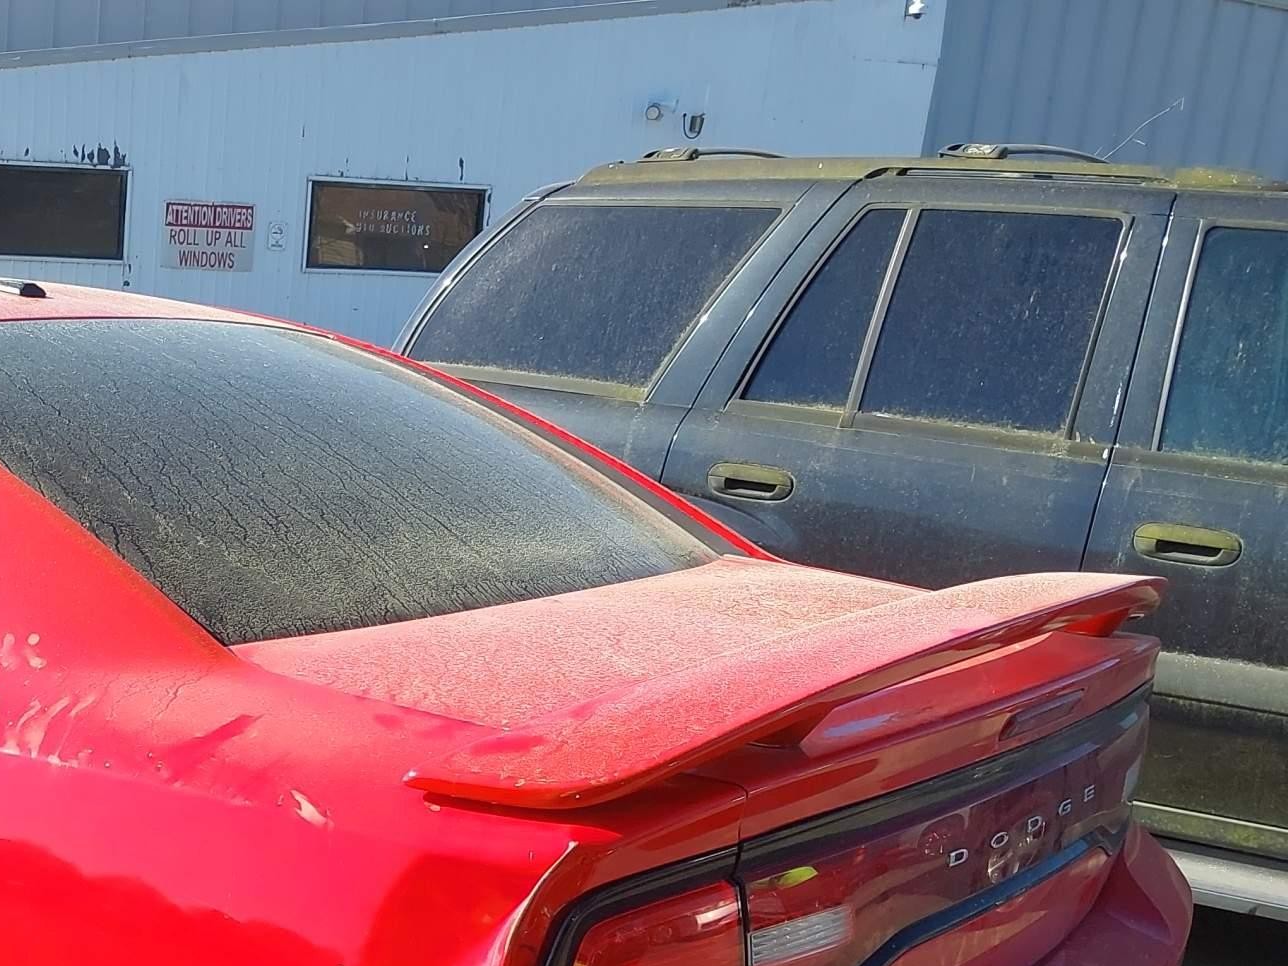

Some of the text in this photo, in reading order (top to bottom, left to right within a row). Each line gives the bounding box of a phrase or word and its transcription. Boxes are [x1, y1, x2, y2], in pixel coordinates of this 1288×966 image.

[166, 204, 252, 228] ATTENTION DRIVERS
[359, 209, 417, 223] INSURANCE
[169, 229, 246, 248] ROLL UP ALL
[178, 250, 235, 269] WINDOWS
[948, 784, 1097, 867] DODGE
